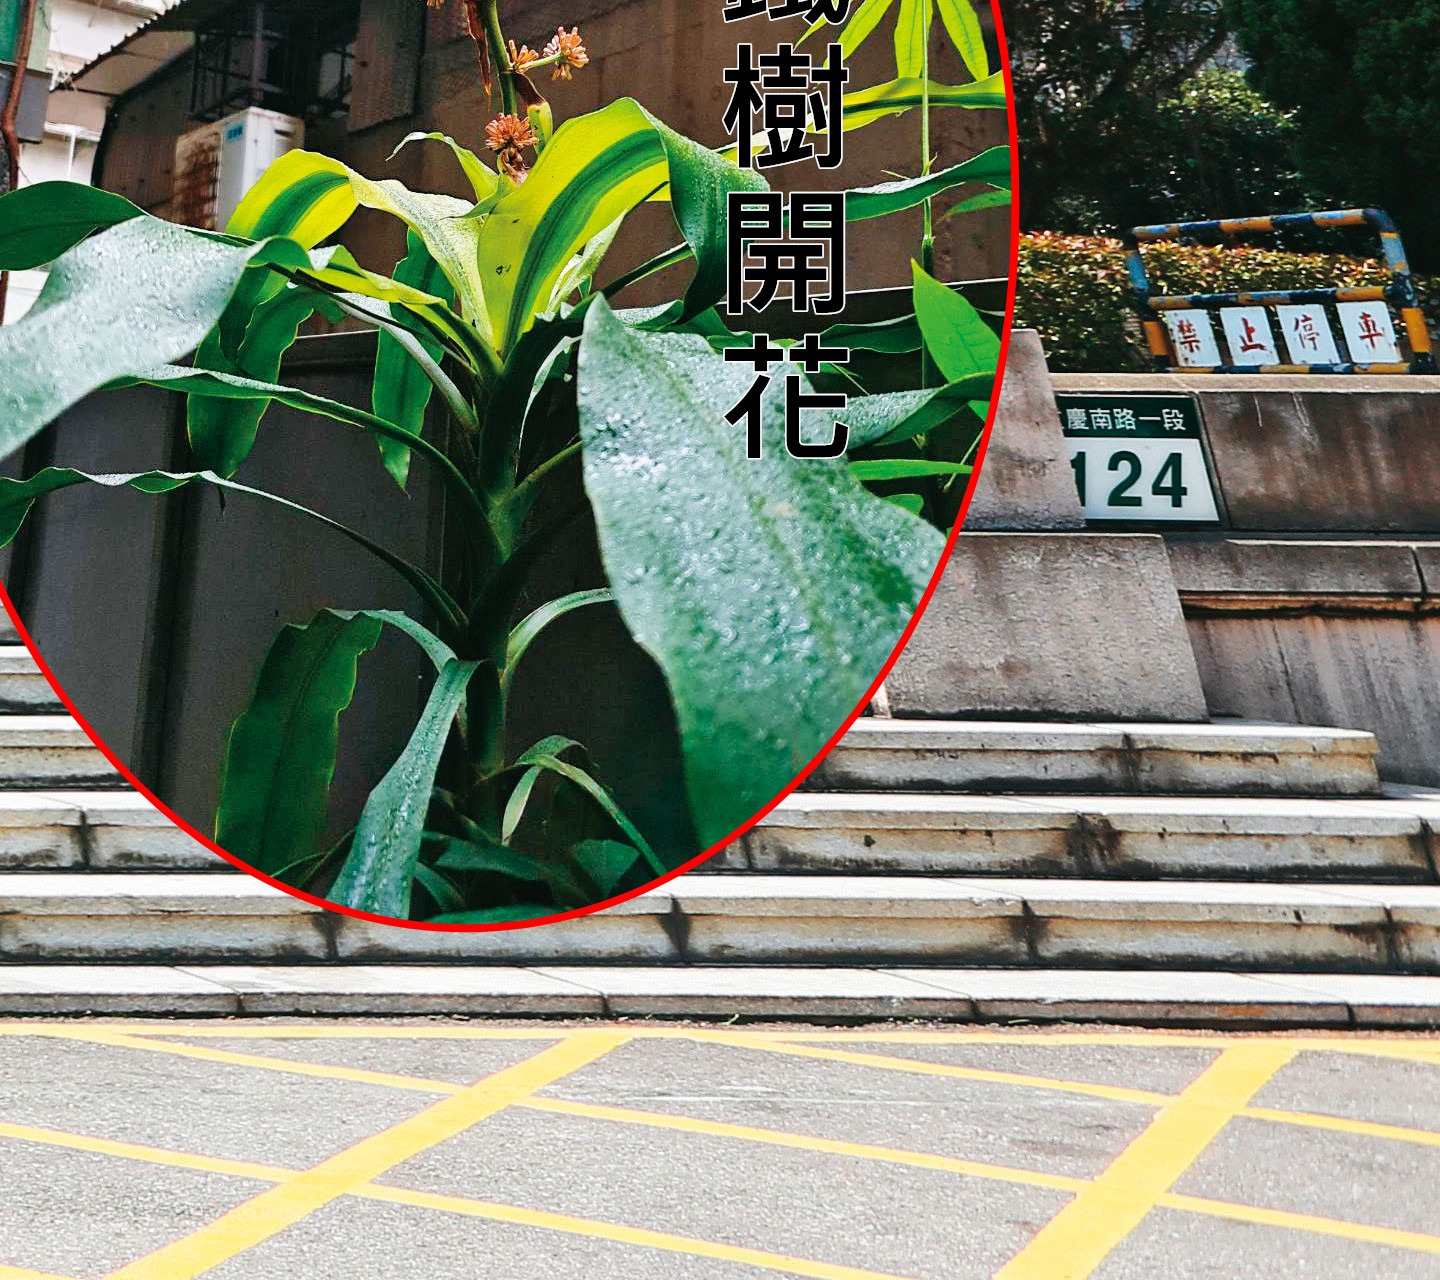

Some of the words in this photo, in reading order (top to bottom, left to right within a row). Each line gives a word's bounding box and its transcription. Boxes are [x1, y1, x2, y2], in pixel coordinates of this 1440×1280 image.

[1177, 310, 1384, 353] 禁止停車
[1057, 408, 1187, 431] 慶南路一段
[1070, 450, 1188, 508] 124
